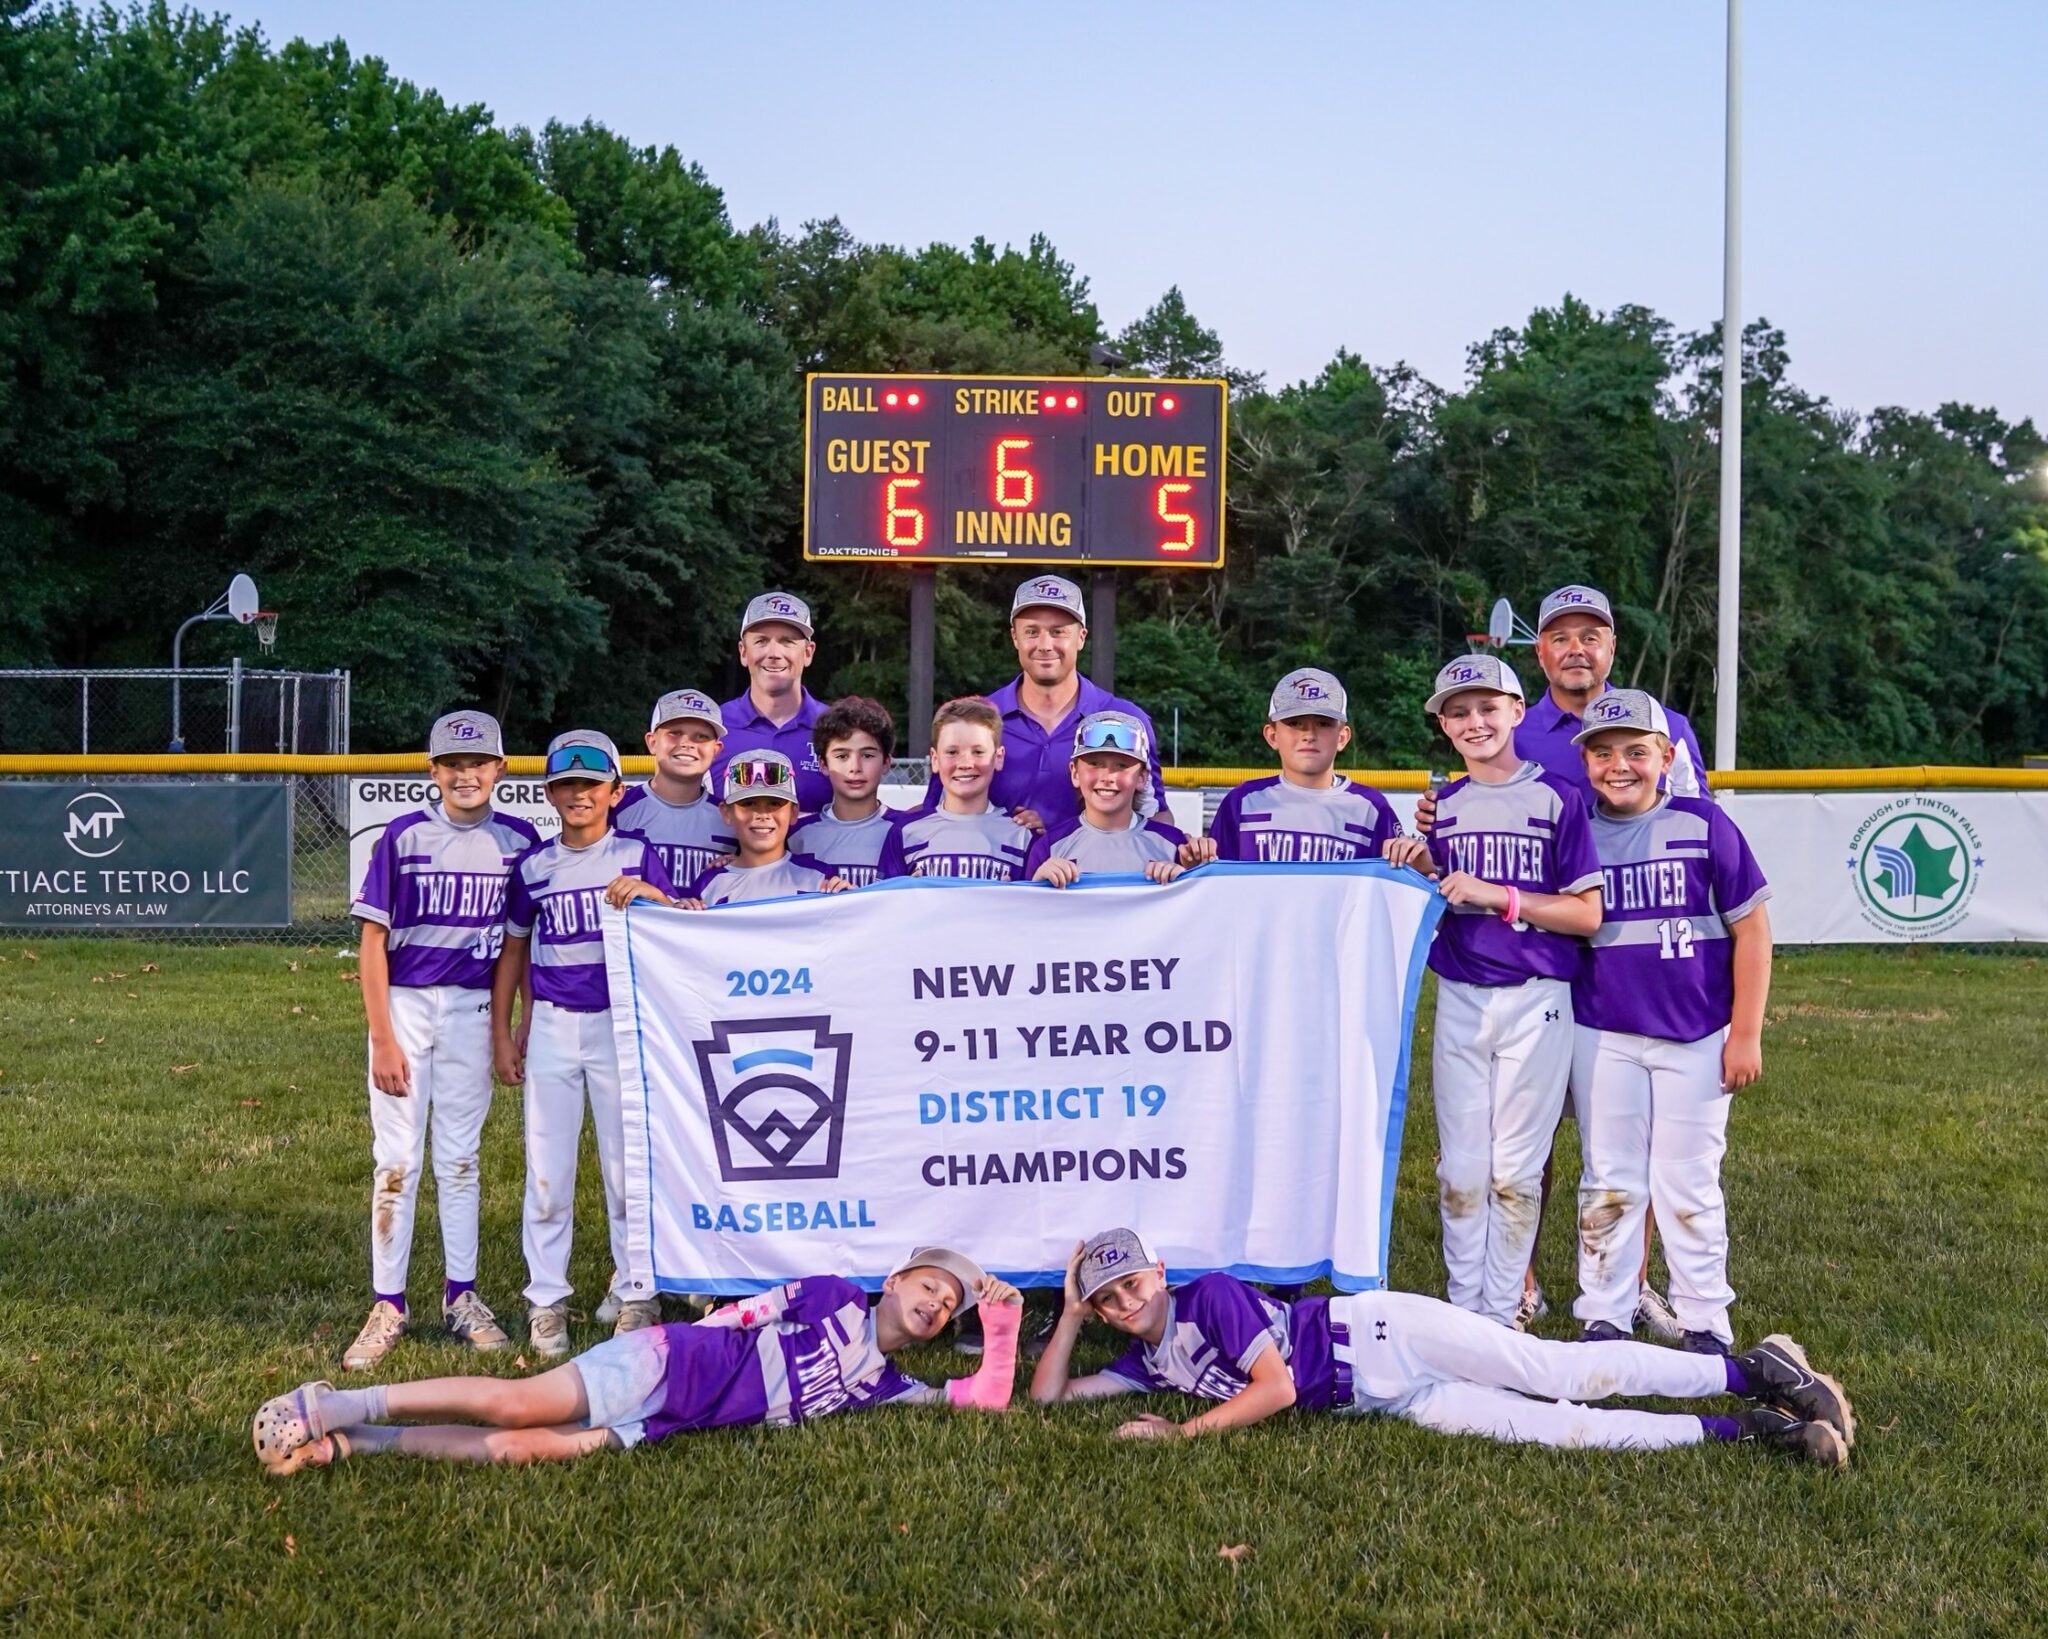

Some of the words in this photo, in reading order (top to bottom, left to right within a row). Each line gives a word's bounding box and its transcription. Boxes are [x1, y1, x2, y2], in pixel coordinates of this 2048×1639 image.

[822, 387, 879, 412] BALL
[955, 388, 1040, 415] STRIKE
[1107, 391, 1156, 418] OUT
[827, 439, 931, 475] GUEST
[996, 439, 1033, 507] 6
[1095, 444, 1207, 478] HOME
[886, 478, 924, 546] 6
[955, 511, 1072, 547] INNING
[1157, 484, 1195, 551] 5
[818, 547, 899, 557] DAKTRONICS
[64, 811, 125, 839] MT
[1849, 803, 1894, 851] BOROUGH
[1896, 798, 1912, 809] OF
[1915, 797, 1959, 819] TINTON
[1958, 815, 1983, 850] FALLS
[1482, 834, 1544, 884] RIVER
[0, 870, 87, 893] TIACE
[99, 870, 190, 893] TETRO
[203, 870, 249, 893] LLC
[415, 874, 456, 918] TWO
[1622, 860, 1687, 912] RIVER
[26, 903, 111, 916] ATTORNEYS
[115, 904, 133, 916] AT
[137, 904, 168, 916] LAW
[541, 893, 578, 936] TWO
[1657, 918, 1695, 960] 12
[726, 967, 813, 997] 2024
[913, 964, 1015, 999] NEW
[1028, 957, 1180, 996] JERSEY
[914, 1027, 998, 1062] 9-11
[1016, 1023, 1131, 1058] YEAR
[1144, 1020, 1232, 1054] OLD
[919, 1086, 1104, 1125] DISTRICT
[1122, 1084, 1167, 1117] 19
[921, 1147, 1187, 1187] CHAMPIONS
[691, 1199, 876, 1234] BASEBALL
